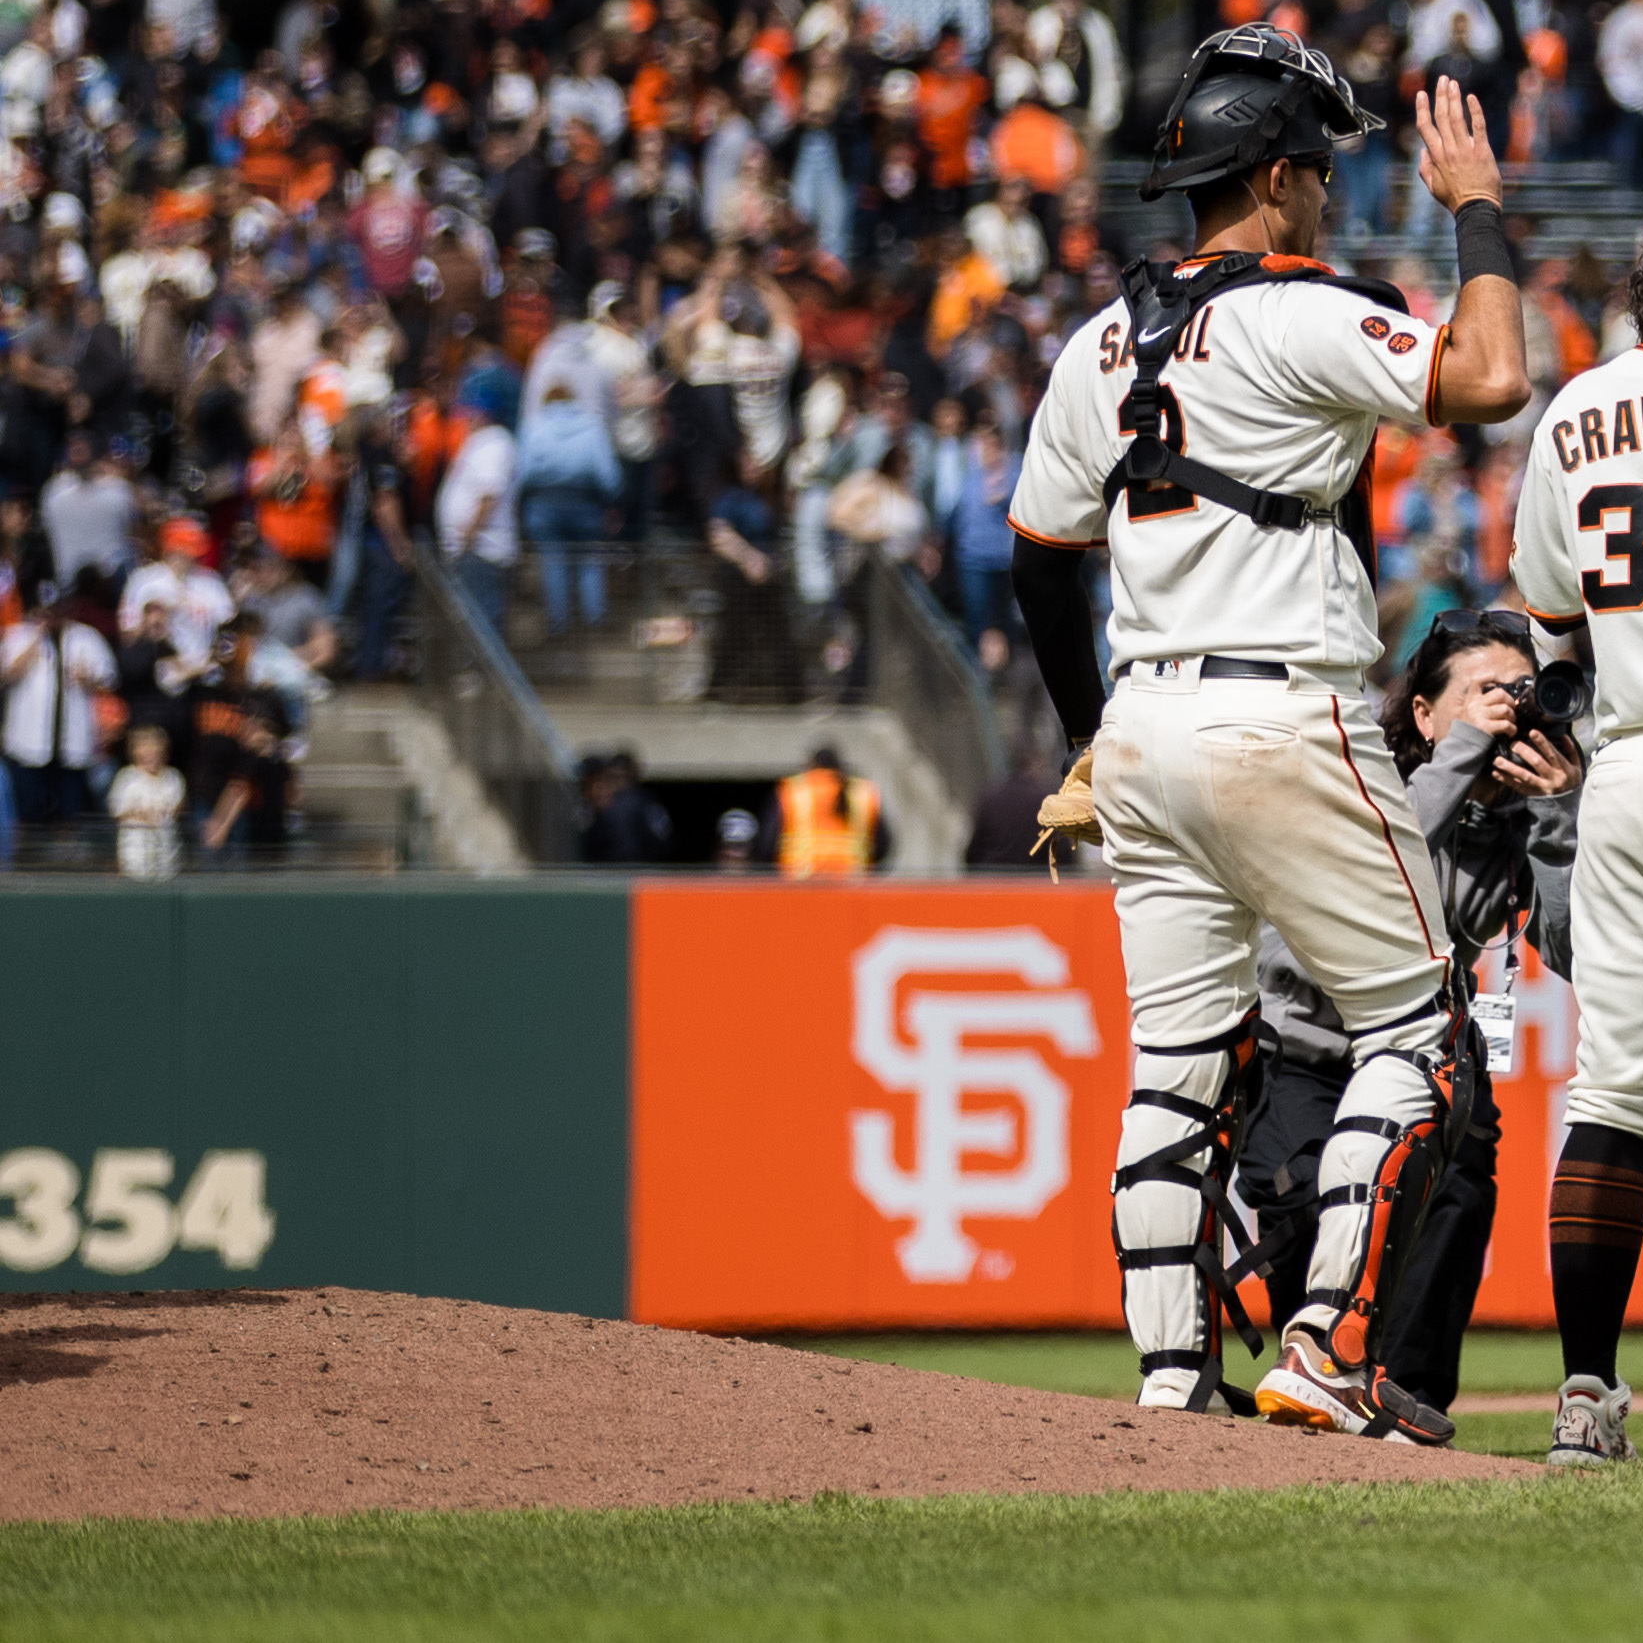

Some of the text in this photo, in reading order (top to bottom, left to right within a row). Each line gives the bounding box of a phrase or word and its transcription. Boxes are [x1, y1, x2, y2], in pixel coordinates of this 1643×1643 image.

[1099, 305, 1214, 374] SAOL
[849, 923, 1103, 1284] SF
[0, 1146, 276, 1275] 354
